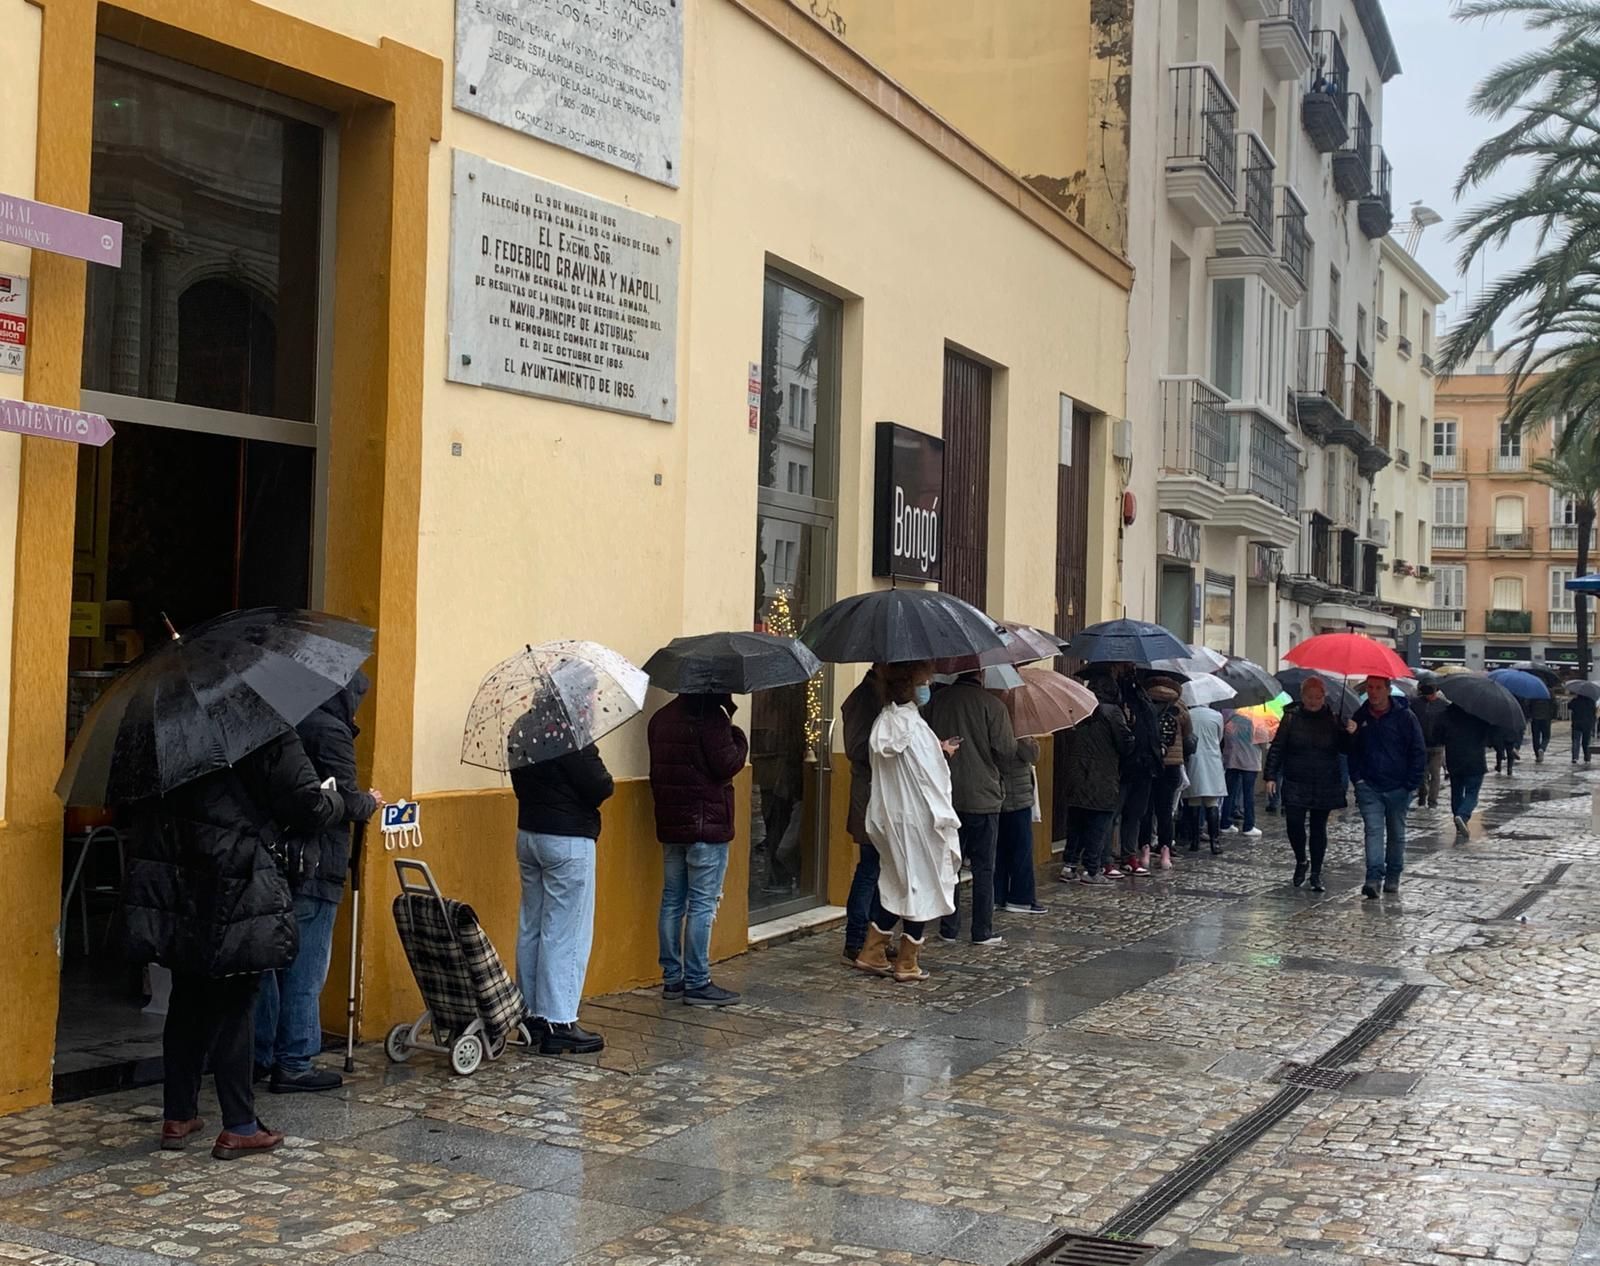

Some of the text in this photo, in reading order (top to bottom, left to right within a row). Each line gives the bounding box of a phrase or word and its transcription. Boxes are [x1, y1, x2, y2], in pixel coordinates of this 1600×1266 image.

[528, 42, 546, 58] ESTA
[607, 144, 618, 156] DE
[535, 193, 544, 204] EL
[553, 199, 562, 210] DE
[564, 203, 588, 219] MARZO
[590, 211, 599, 222] DE
[521, 204, 531, 217] EN
[533, 208, 552, 224] ESTA
[585, 224, 599, 237] LOS
[612, 232, 631, 247] AÑOS
[632, 239, 641, 250] DE
[539, 225, 552, 248] EL
[495, 238, 550, 273] FEDERICO
[556, 256, 606, 288] GRAVINA
[610, 271, 617, 290] Y
[495, 263, 530, 282] CAPITAN
[533, 274, 568, 292] GENERAL
[571, 284, 581, 296] DE
[583, 287, 594, 299] LA
[596, 291, 615, 304] REAL
[475, 275, 486, 286] DE
[489, 279, 525, 297] RESULTAS
[528, 289, 537, 299] DE
[540, 291, 549, 304] LA
[551, 295, 575, 310] HERIDA
[578, 302, 592, 314] QUE
[650, 320, 662, 331] DEL
[489, 314, 650, 361] EN EL MEMORABLE COMBATE DE TRAFALGAR
[580, 317, 590, 332] DE
[520, 337, 530, 348] EL
[533, 340, 541, 352] 21
[543, 342, 553, 354] DE
[556, 346, 591, 363] OCTUBRE
[594, 354, 604, 365] DE
[504, 358, 516, 374] EL
[521, 361, 595, 393] AYUNTAMIENTO
[599, 377, 611, 394] DE
[894, 485, 939, 573] Bongó
[388, 807, 399, 824] P
